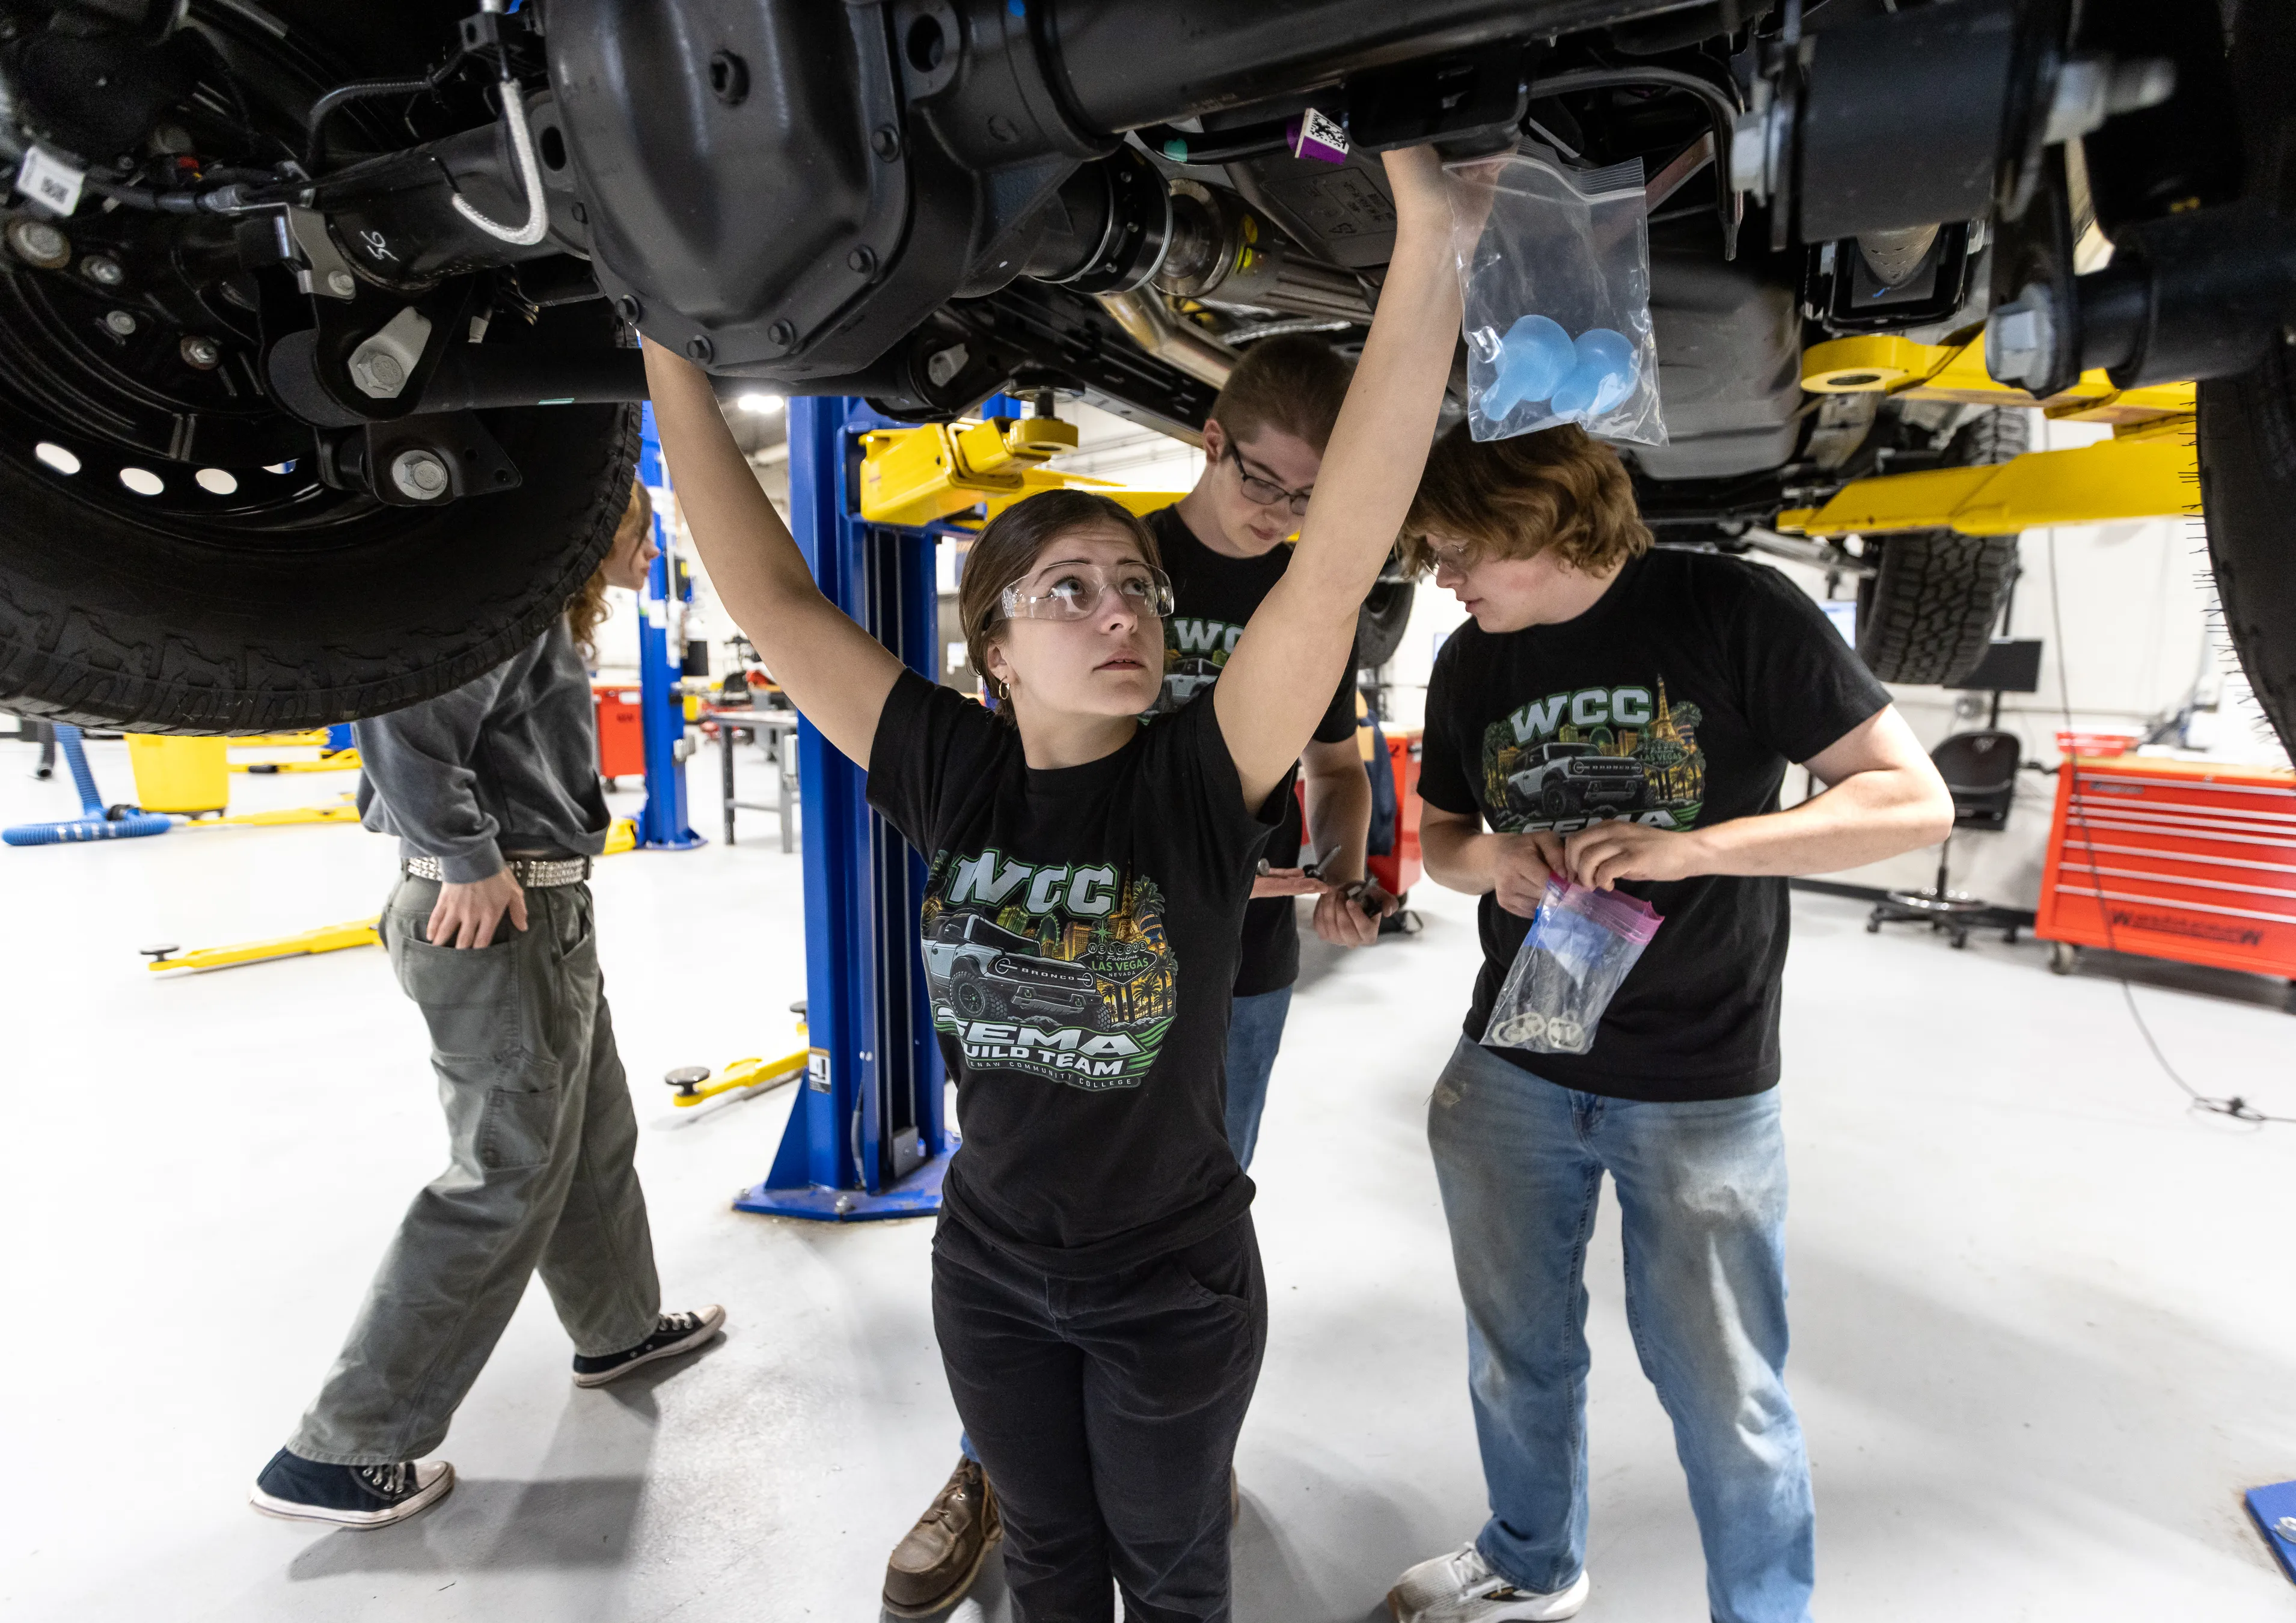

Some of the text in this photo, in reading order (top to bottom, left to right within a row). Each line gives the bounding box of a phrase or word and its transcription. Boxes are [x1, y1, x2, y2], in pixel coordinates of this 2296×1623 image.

[1510, 688, 1652, 744] WCC
[948, 851, 1115, 916] WCC
[1089, 942, 1146, 953] WELCOME
[1021, 967, 1075, 981] BRONCO
[1092, 957, 1149, 971] LAS VEGAS
[937, 1006, 1141, 1056] SEMA
[962, 1042, 1124, 1076] UILD TEAM
[1009, 1061, 1073, 1080] COMMUNITY
[1079, 1077, 1131, 1089] COLLEGE
